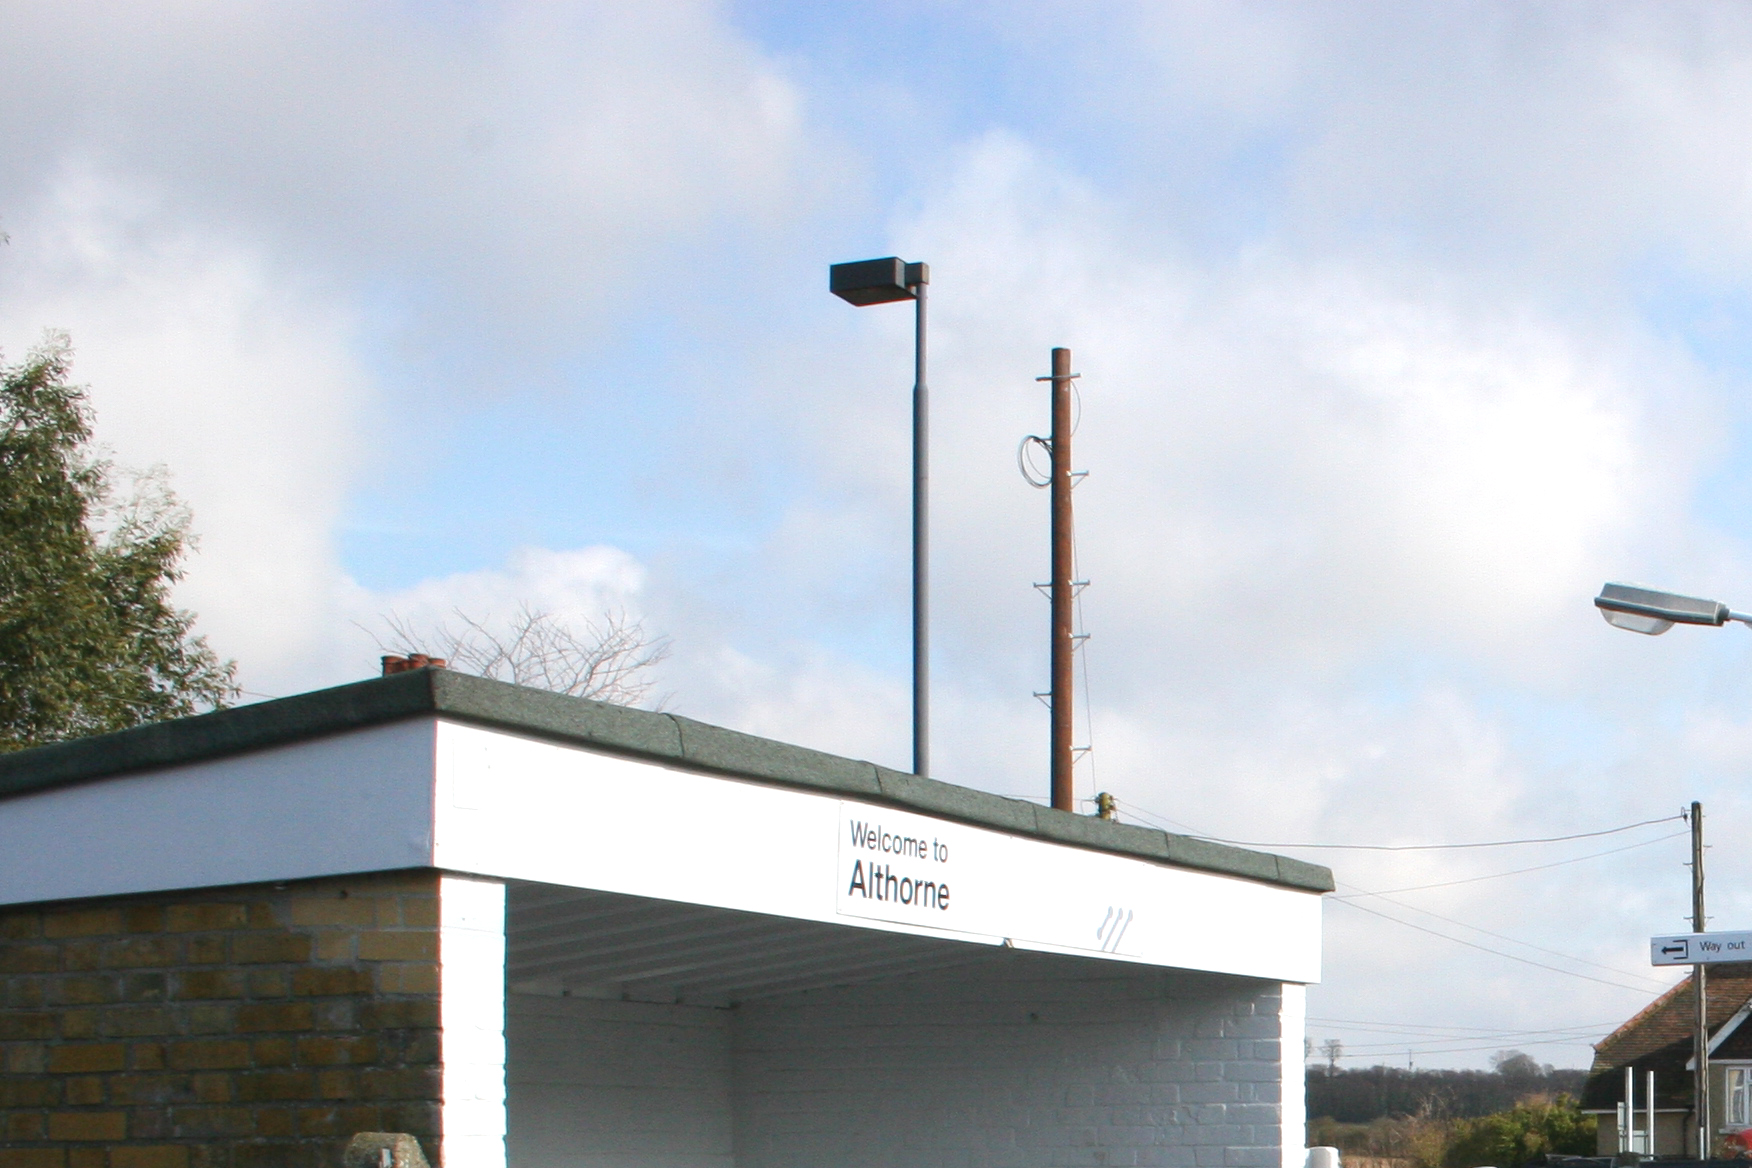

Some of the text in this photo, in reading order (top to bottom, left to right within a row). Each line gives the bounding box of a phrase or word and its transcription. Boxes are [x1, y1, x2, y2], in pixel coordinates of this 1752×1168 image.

[849, 819, 949, 863] Welcome to
[848, 858, 951, 911] Althorne
[1699, 940, 1746, 953] Way out
